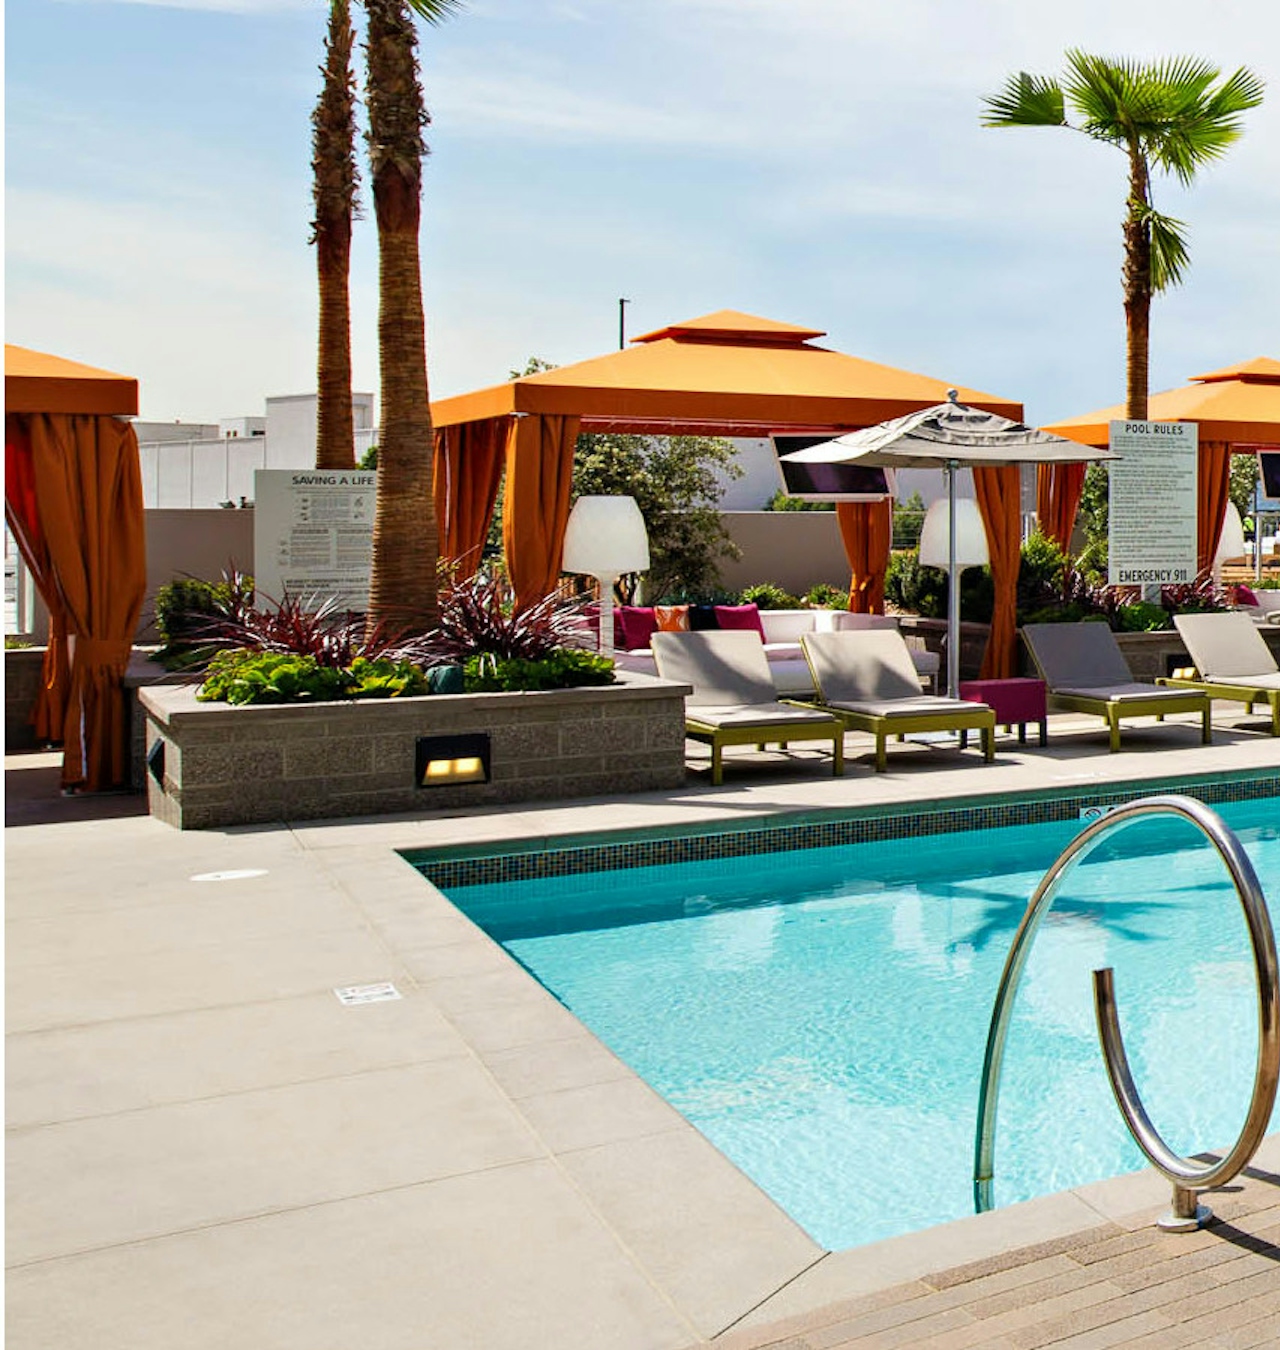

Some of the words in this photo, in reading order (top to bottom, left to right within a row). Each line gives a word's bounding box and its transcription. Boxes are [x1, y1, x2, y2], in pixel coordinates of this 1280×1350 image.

[1125, 424, 1151, 434] POOL
[1154, 425, 1183, 435] RULES
[292, 476, 337, 485] SAVING
[339, 476, 348, 485] A
[352, 476, 375, 485] LIFE
[1119, 570, 1172, 582] EMERGENCY
[1174, 569, 1187, 581] 911
